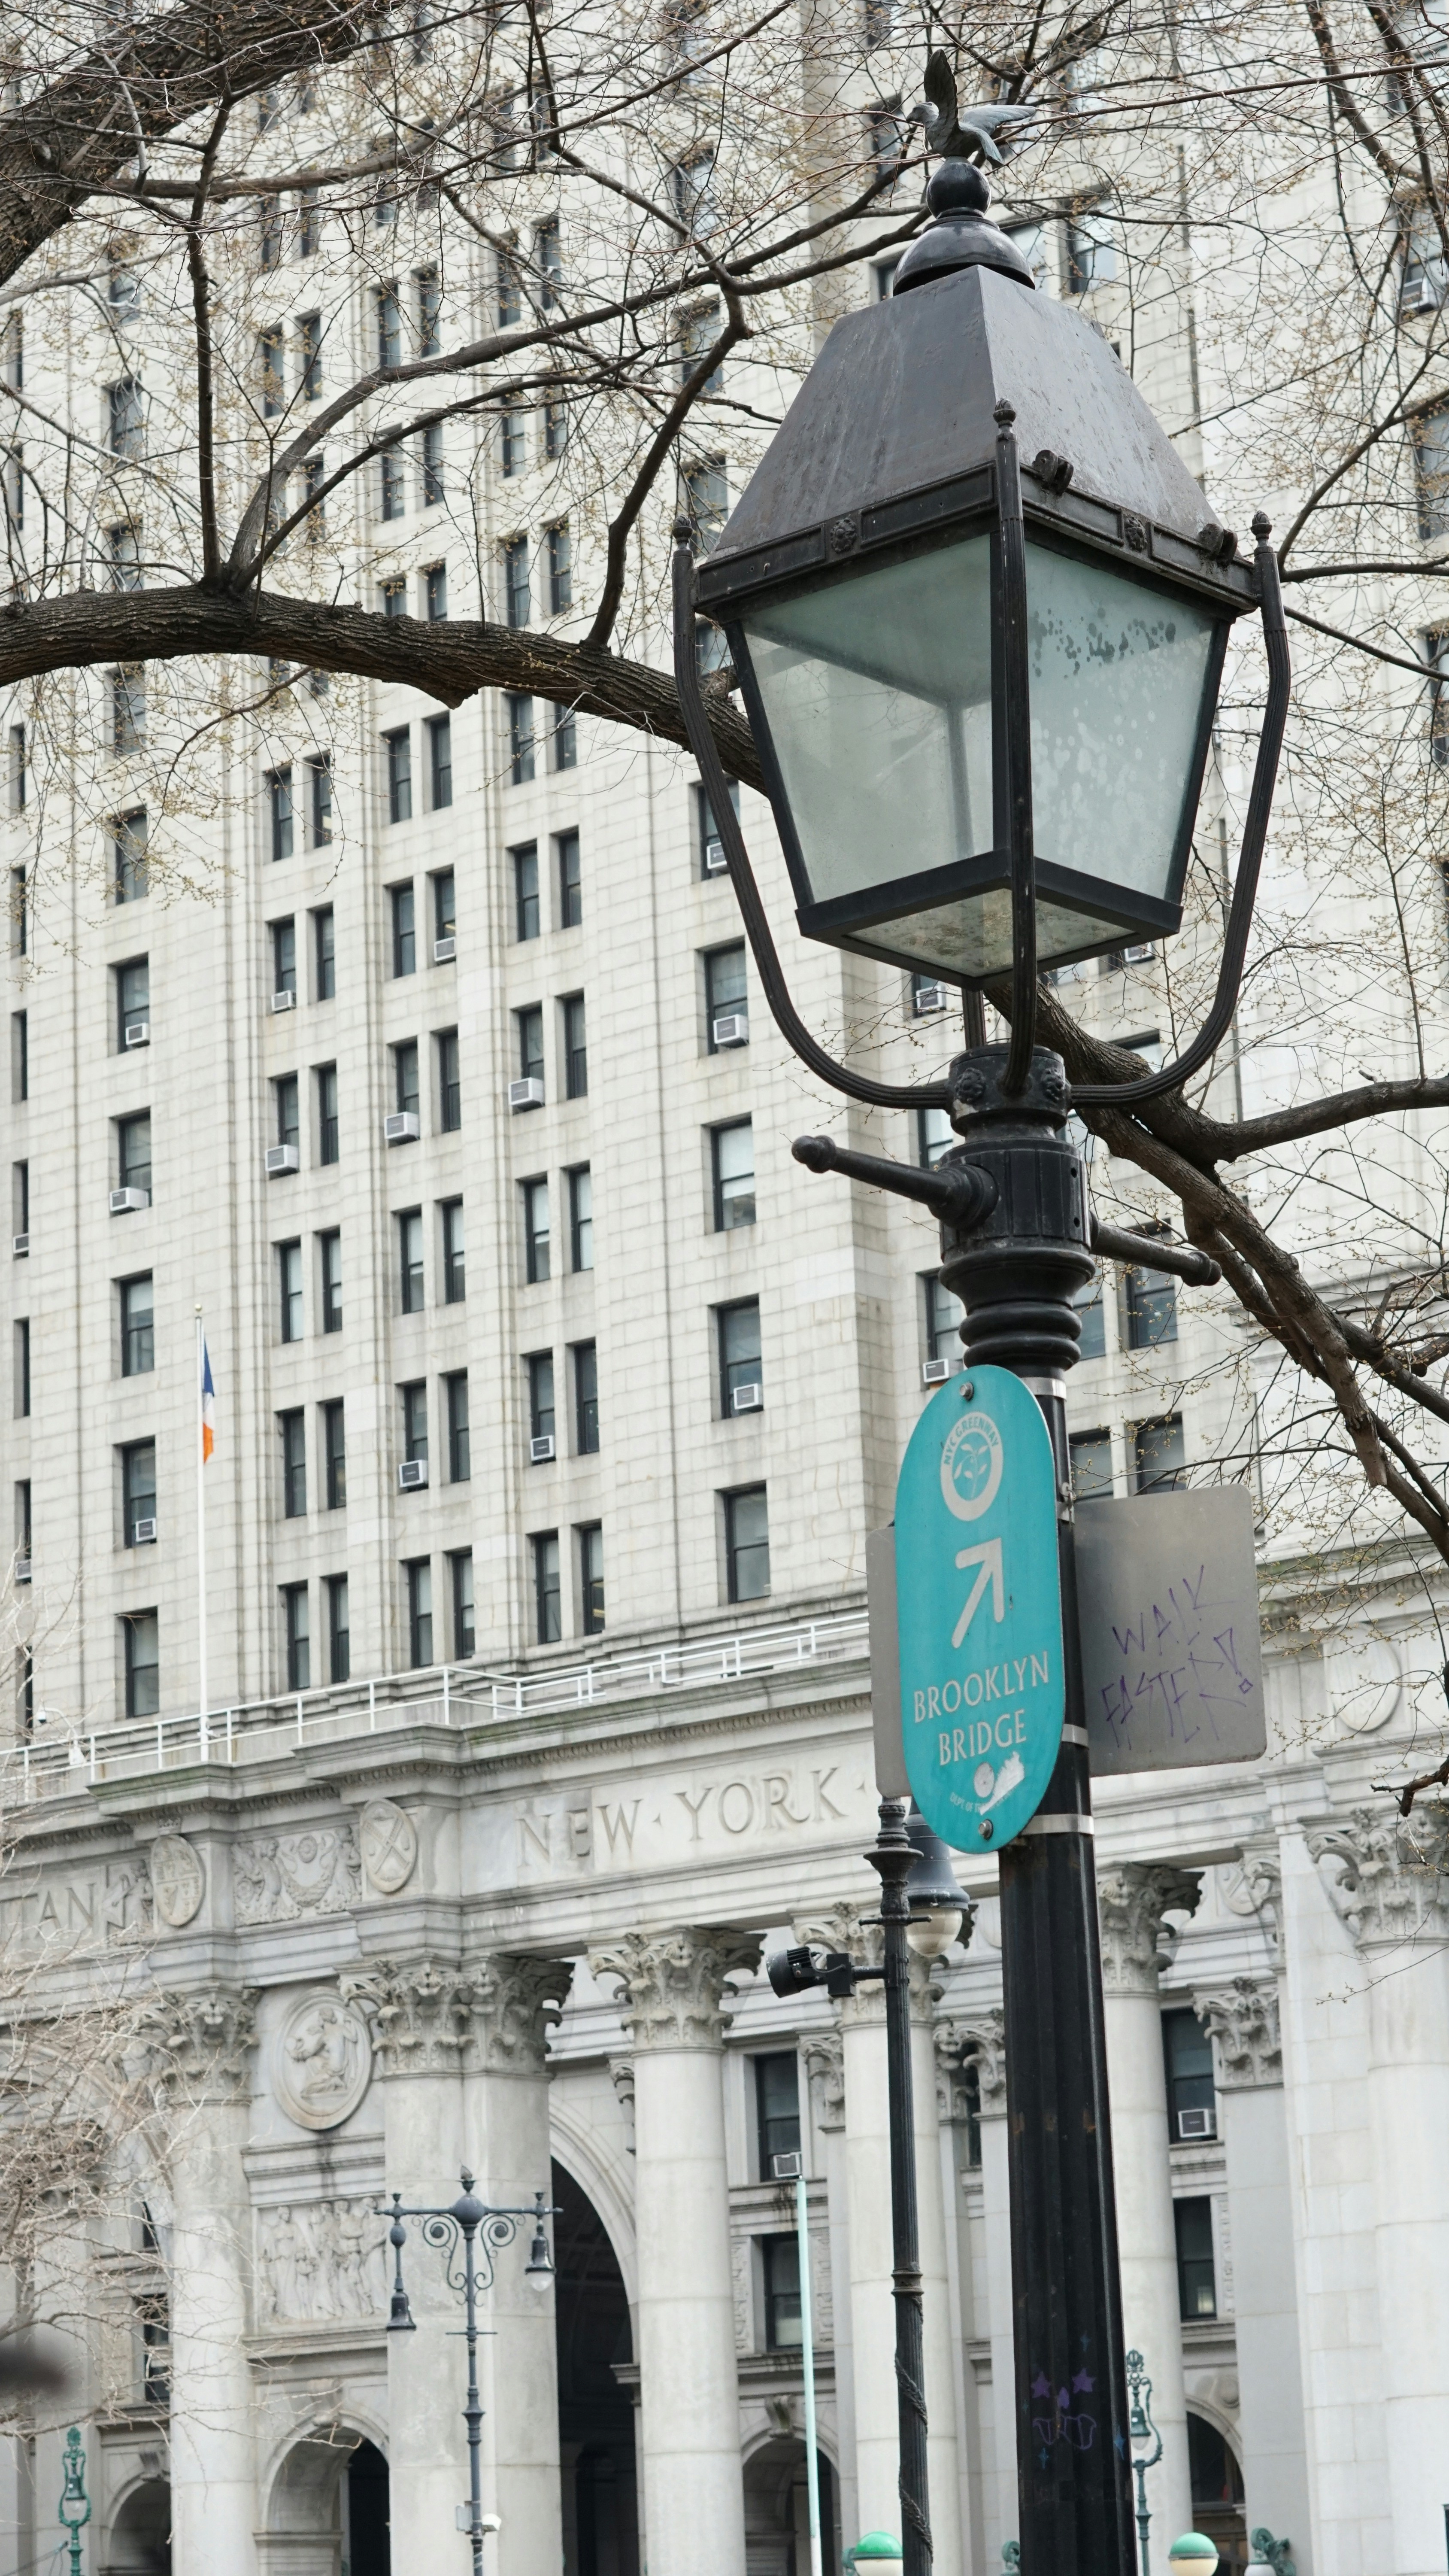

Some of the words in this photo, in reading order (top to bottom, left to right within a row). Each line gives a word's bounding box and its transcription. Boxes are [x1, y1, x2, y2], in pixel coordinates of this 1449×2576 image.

[944, 1437, 956, 1465] NYC
[955, 1416, 999, 1447] GREENWAY
[1112, 1564, 1245, 1656] WALK
[914, 1651, 1049, 1724] BROOKLYN
[939, 1709, 1027, 1766] BRIDGE
[515, 1798, 642, 1867] NEW
[674, 1767, 849, 1842] YORK
